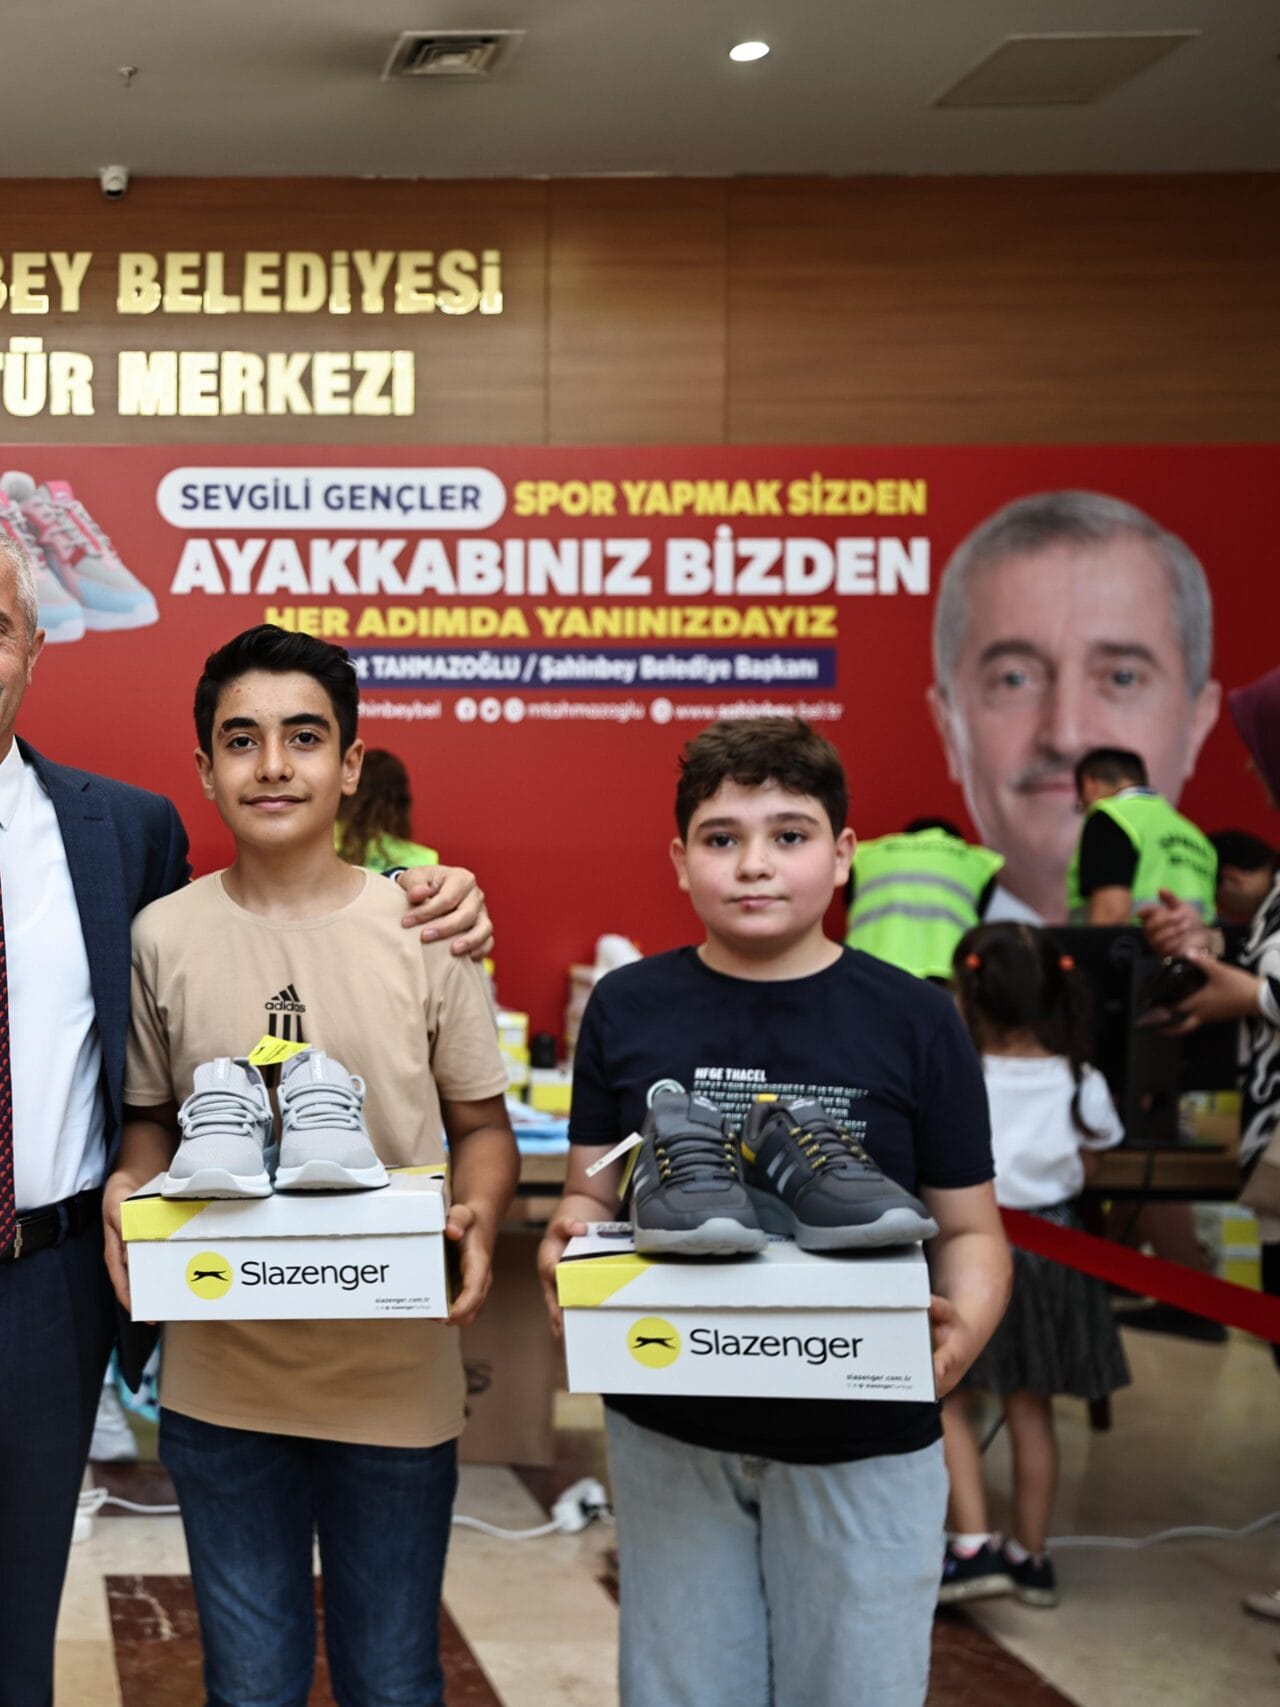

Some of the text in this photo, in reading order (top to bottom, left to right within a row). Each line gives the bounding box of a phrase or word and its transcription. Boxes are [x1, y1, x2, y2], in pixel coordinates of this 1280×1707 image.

[116, 249, 504, 315] BELEDİYESİ
[179, 476, 482, 517] SEVGİLİ GENÇLER
[513, 472, 927, 516] SPOR YAPMAK SİZDEN
[170, 524, 930, 596] AYAKKABINIZ BİZDEN
[264, 606, 838, 638] HER ADIMDA YANINIZDAYIZ
[372, 650, 521, 680] TAHMAZOĞLU
[539, 654, 637, 684] Şahinbey
[639, 654, 732, 684] Belediye
[265, 1000, 306, 1013] adidas
[240, 1261, 390, 1290] Slazenger
[689, 1328, 864, 1365] Slazenger
